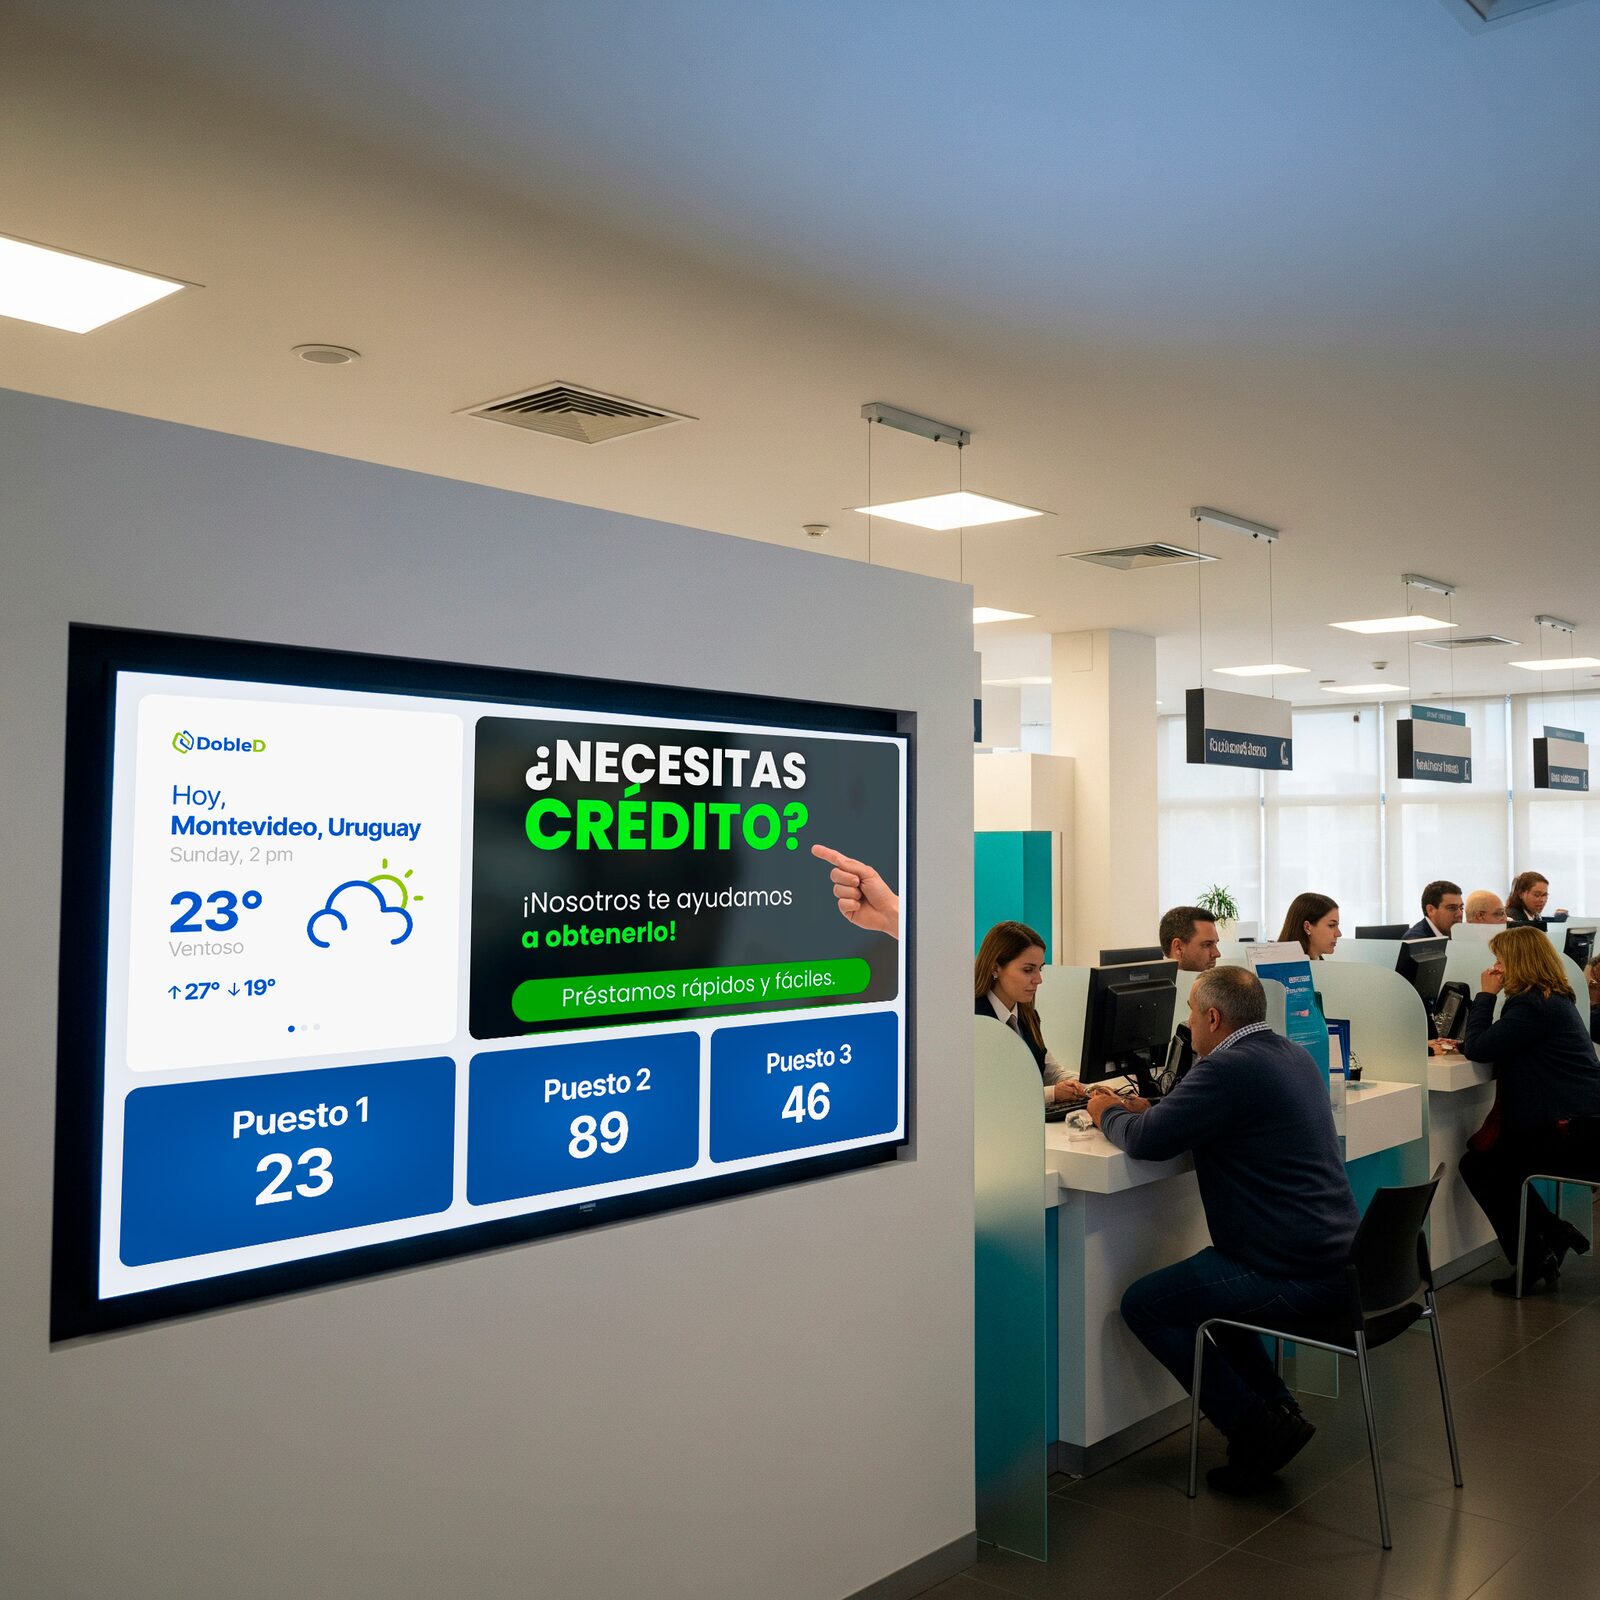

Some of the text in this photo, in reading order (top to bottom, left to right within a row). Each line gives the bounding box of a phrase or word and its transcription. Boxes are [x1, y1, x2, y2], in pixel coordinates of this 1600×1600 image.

[196, 736, 267, 753] DobleD
[525, 739, 806, 791] ¿NECESITAS
[172, 785, 226, 811] Hoy,
[170, 815, 422, 842] Montevideo, Uruguay
[525, 782, 808, 850] CRÉDITO?
[170, 846, 293, 866] Sunday, 2 pm
[169, 889, 263, 934] 23°
[522, 886, 793, 918] ¡Nosotros te ayudamos
[168, 941, 244, 957] Ventoso
[521, 920, 676, 949] a obtenerlo!
[185, 978, 276, 1001] 27° 19°
[562, 969, 836, 1007] Préstamos rápidos y fáciles.
[766, 1043, 853, 1075] Puesto 3
[544, 1067, 651, 1103] Puesto 2
[232, 1096, 369, 1139] Puesto 1
[781, 1081, 831, 1124] 46
[568, 1110, 629, 1159] 89
[255, 1147, 334, 1206] 23
